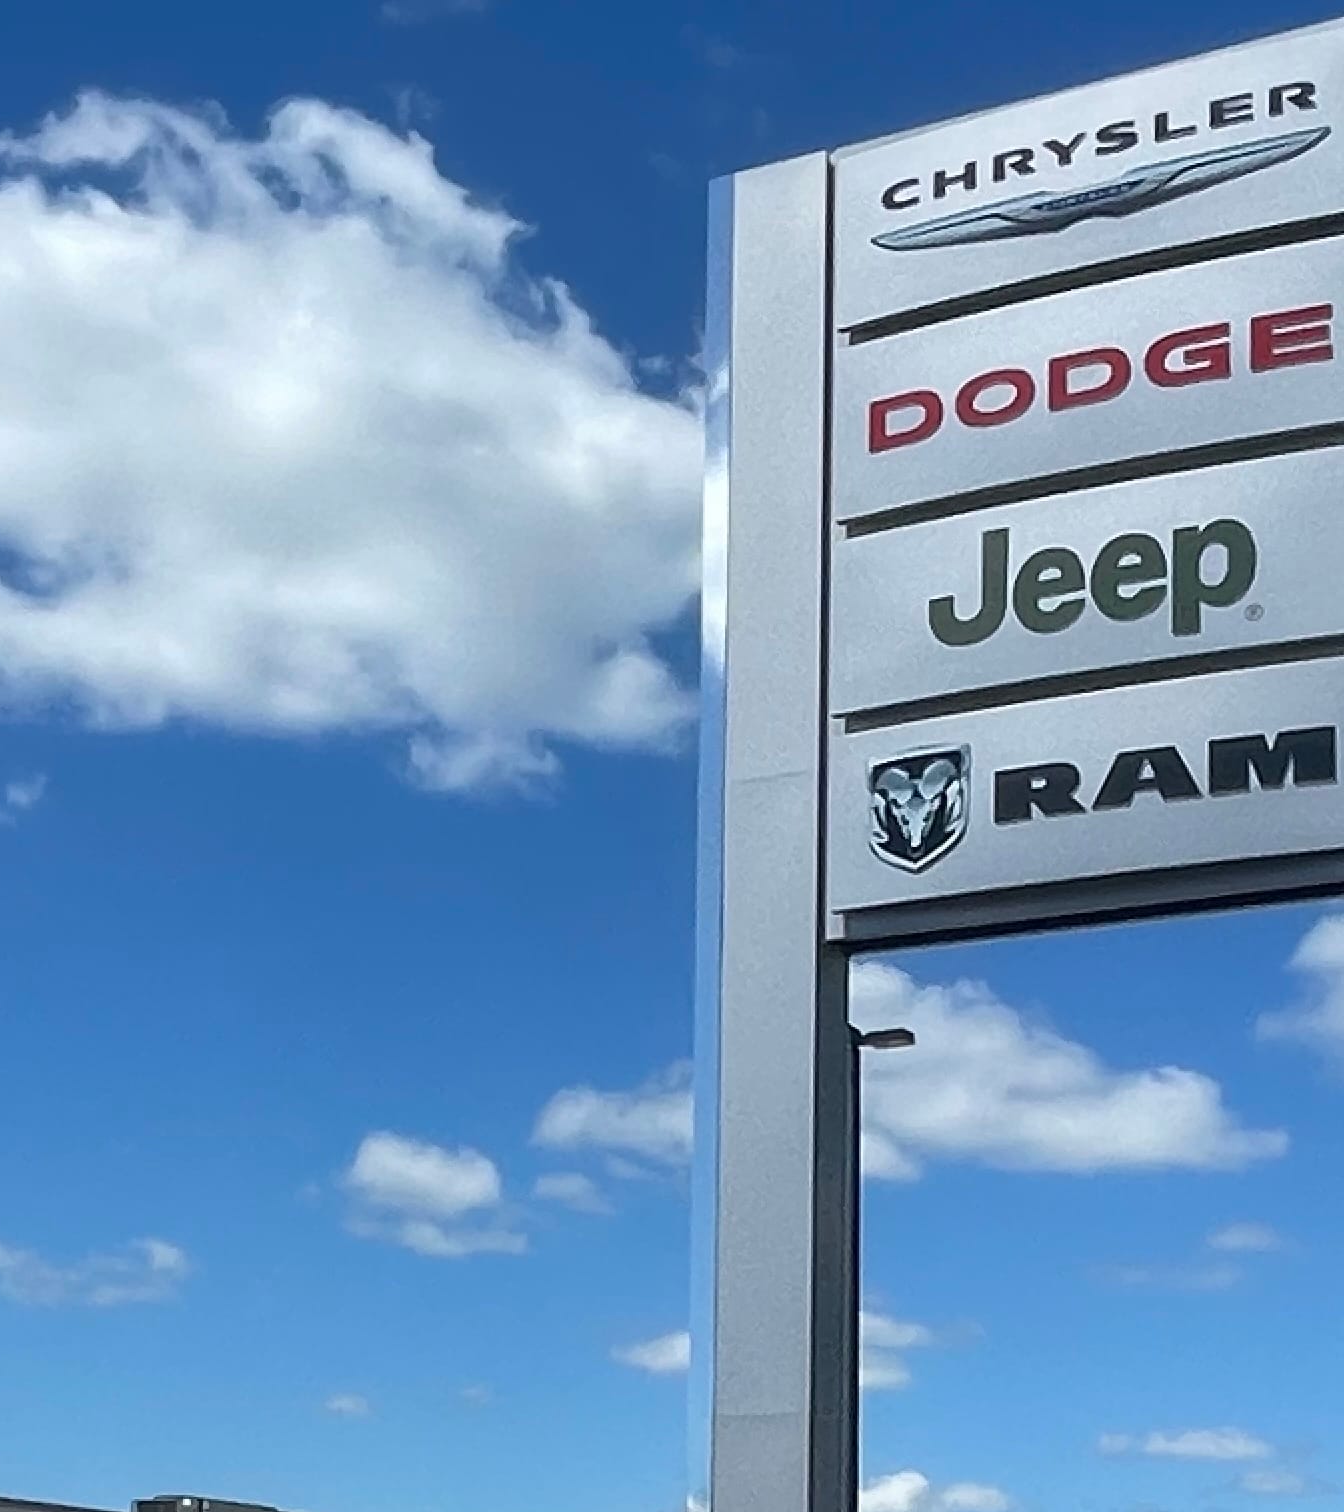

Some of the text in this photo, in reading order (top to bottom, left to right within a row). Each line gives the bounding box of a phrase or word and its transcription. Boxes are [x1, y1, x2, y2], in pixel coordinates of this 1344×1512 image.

[880, 80, 1318, 211] CHRYSLER
[867, 303, 1335, 455] DODGE
[927, 518, 1257, 647] Jeep
[993, 724, 1337, 826] RAM
